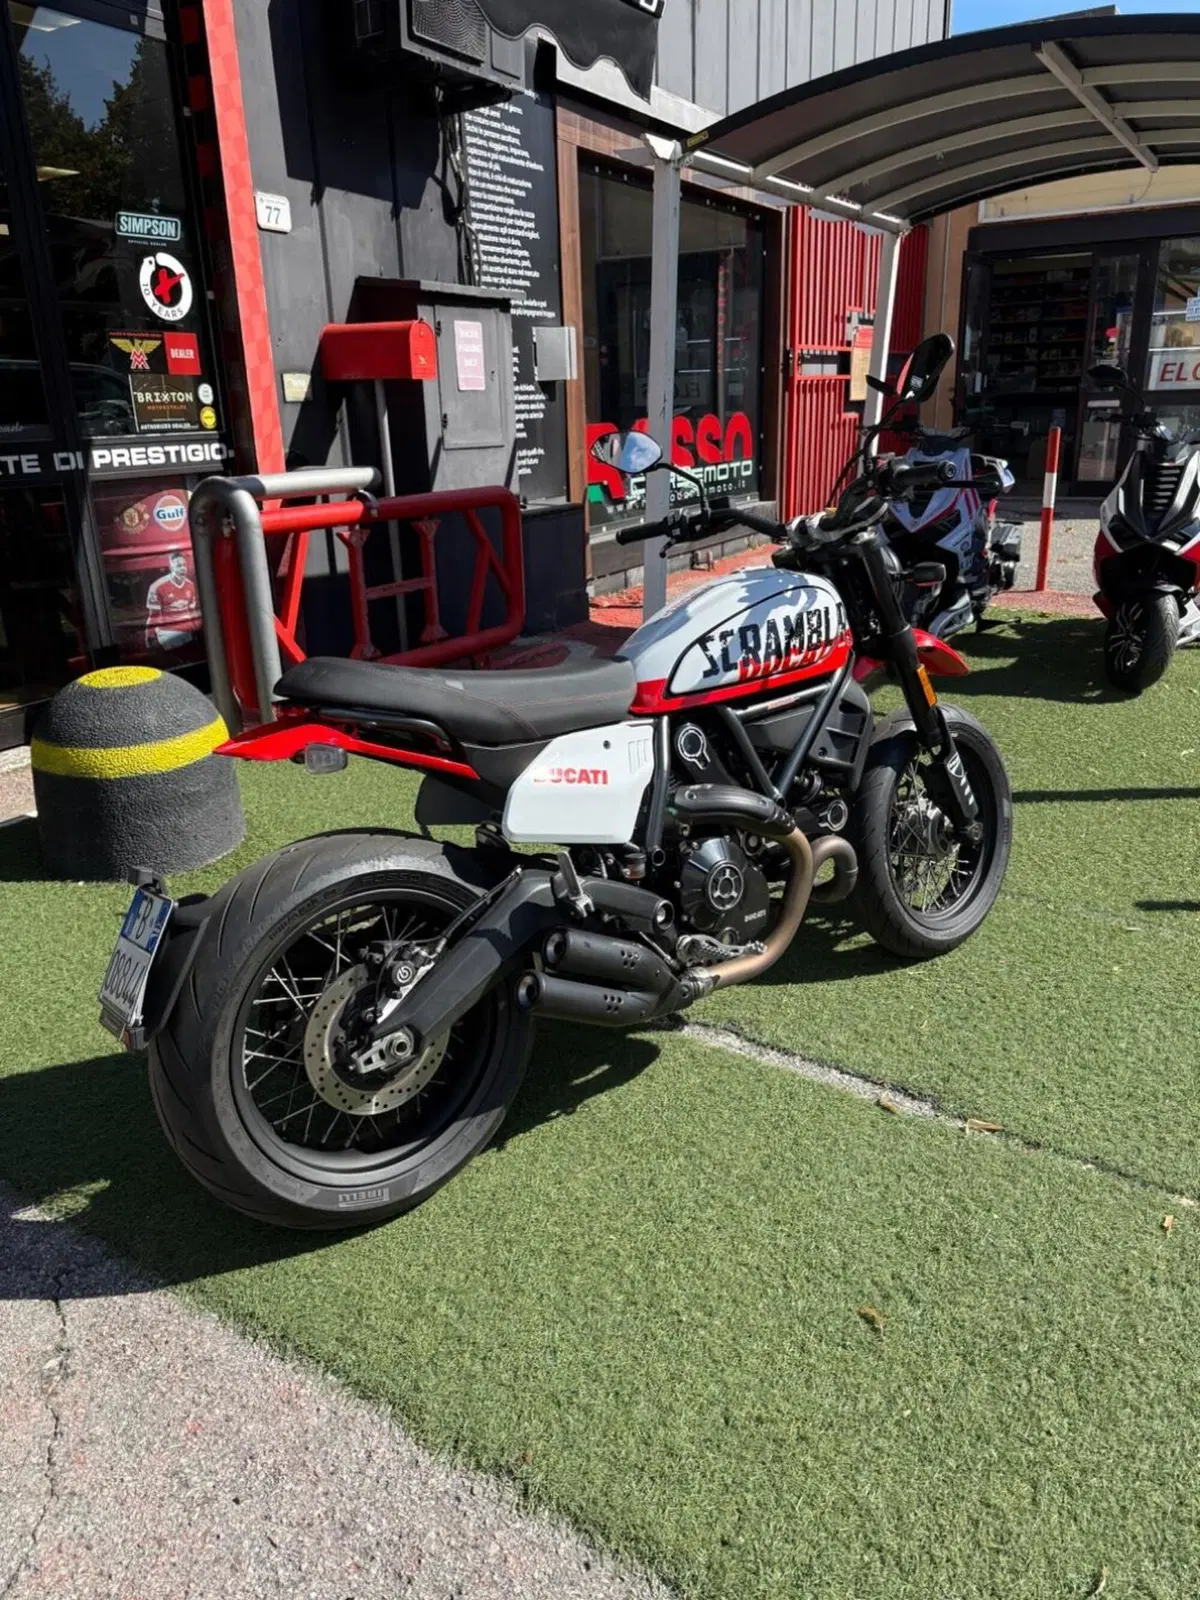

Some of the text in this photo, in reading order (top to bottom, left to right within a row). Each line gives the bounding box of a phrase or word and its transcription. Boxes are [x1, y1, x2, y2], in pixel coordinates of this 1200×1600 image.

[265, 205, 280, 225] 77
[119, 216, 176, 238] SIMPSON
[151, 300, 184, 319] YEARS
[170, 348, 195, 359] DEALER
[136, 391, 194, 403] BRIXTON
[0, 442, 228, 475] TE DI PRESTIGIO
[156, 508, 185, 521] Gulf
[534, 767, 609, 786] UCATI
[338, 1187, 390, 1207] PIRELLI
